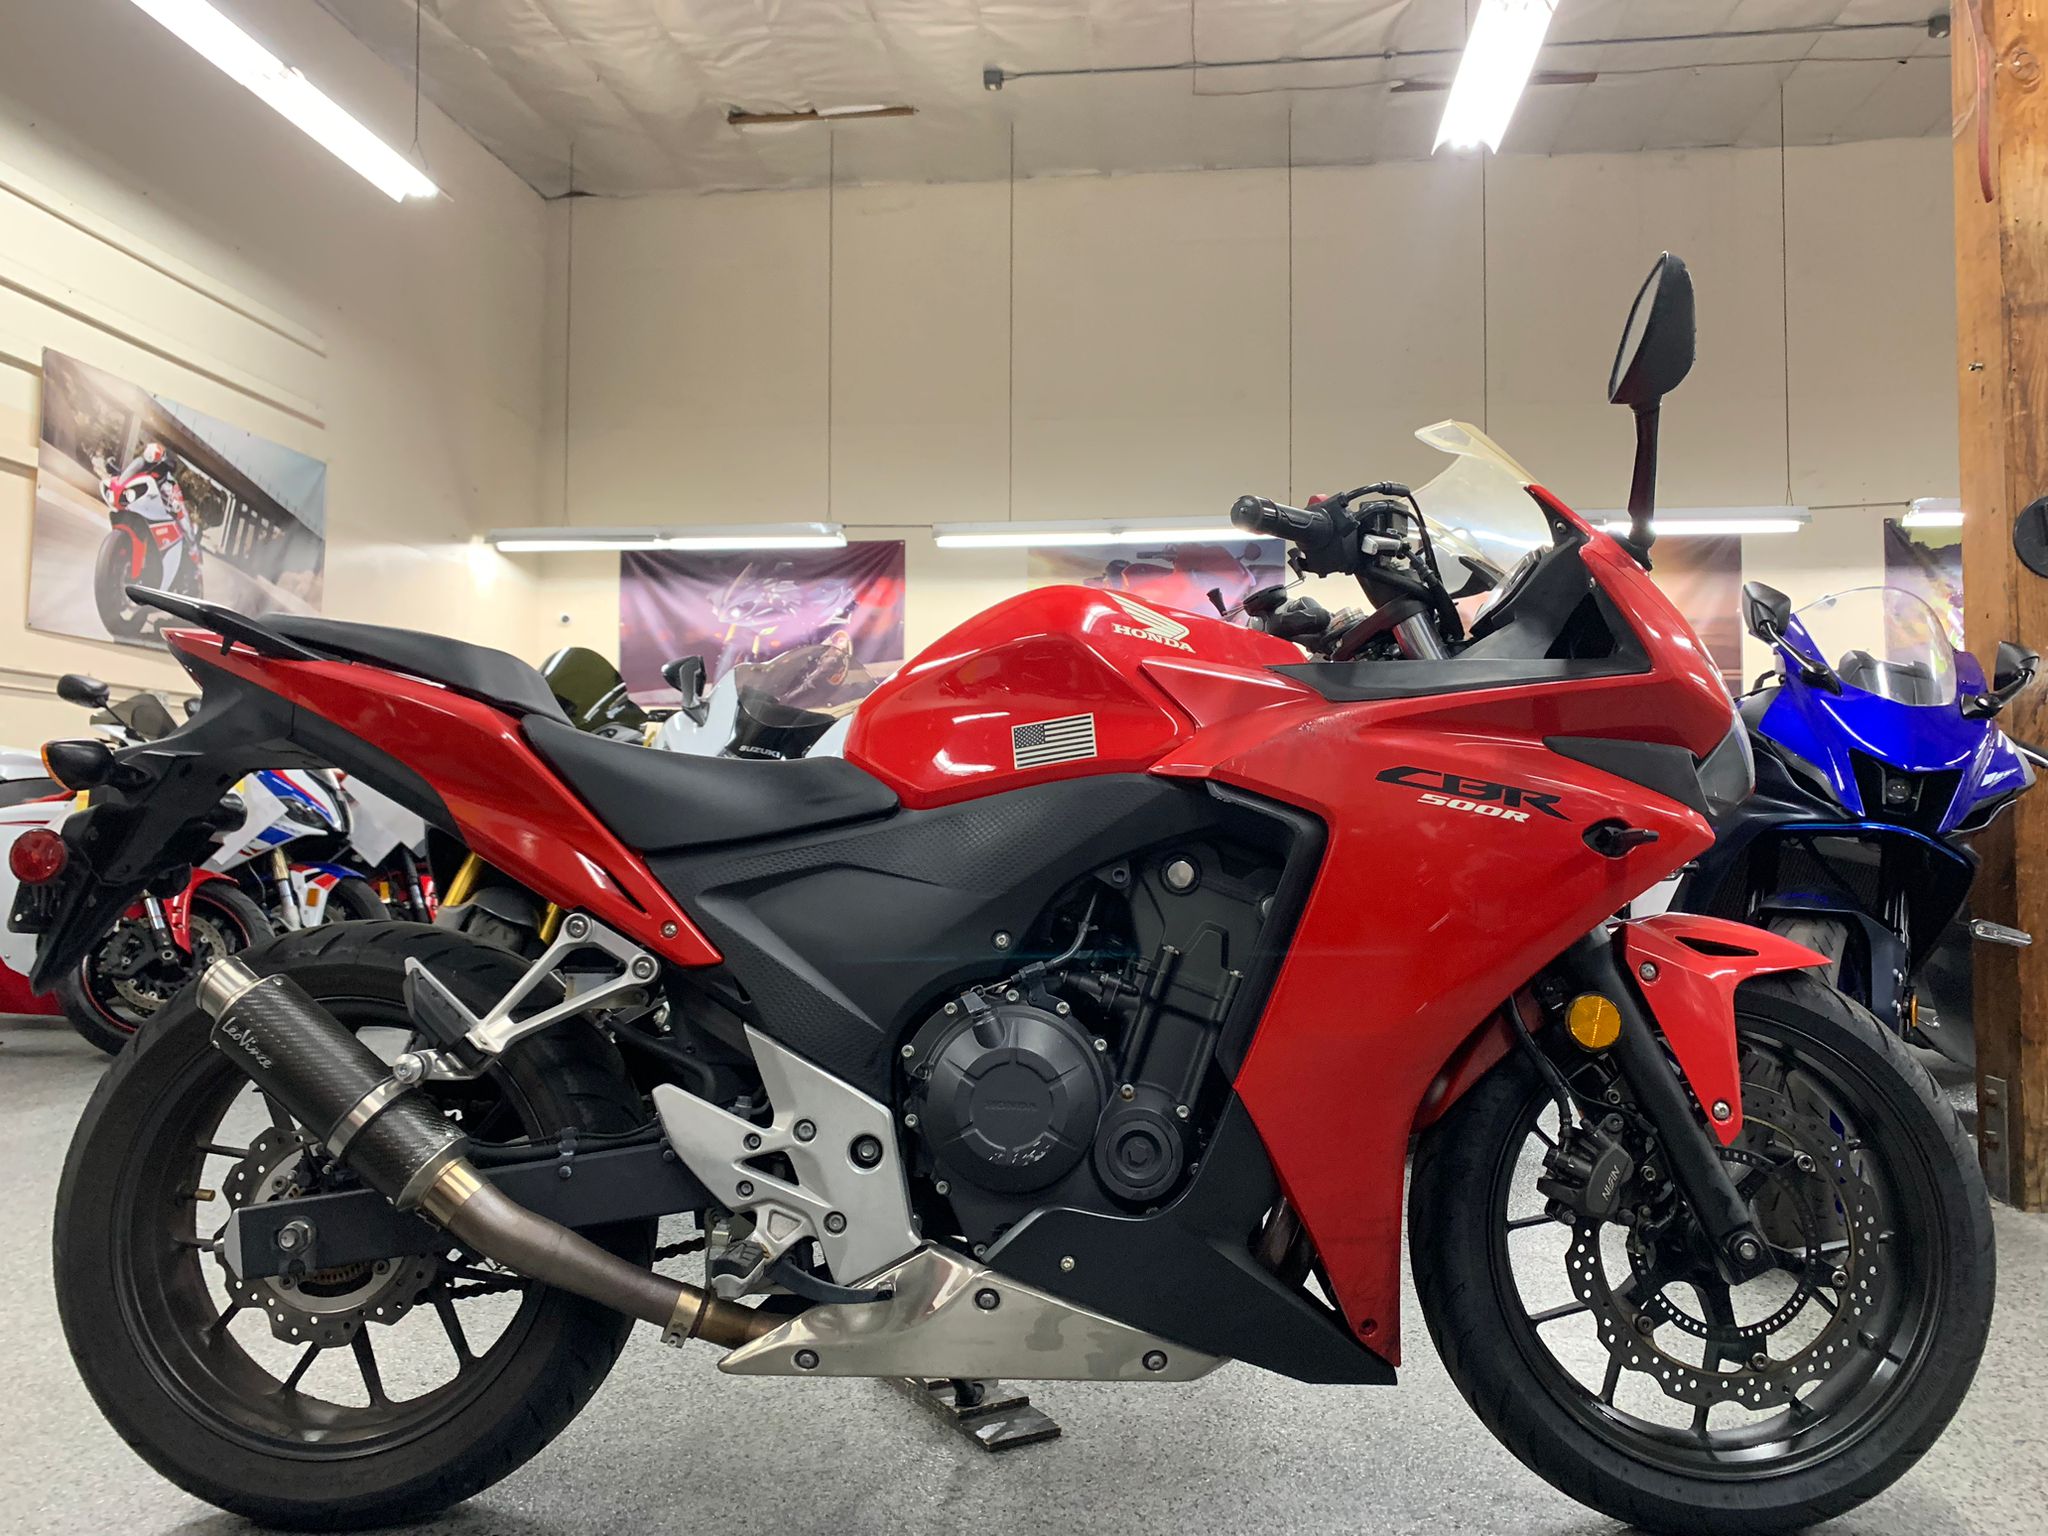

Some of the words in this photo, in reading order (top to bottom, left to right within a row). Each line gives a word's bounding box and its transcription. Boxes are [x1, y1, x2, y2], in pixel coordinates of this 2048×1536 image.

[1111, 622, 1197, 654] HONDA
[738, 744, 781, 759] SUZUKI
[1375, 765, 1573, 823] CBR
[1416, 793, 1531, 823] 500R
[221, 1016, 272, 1069] LeoVince
